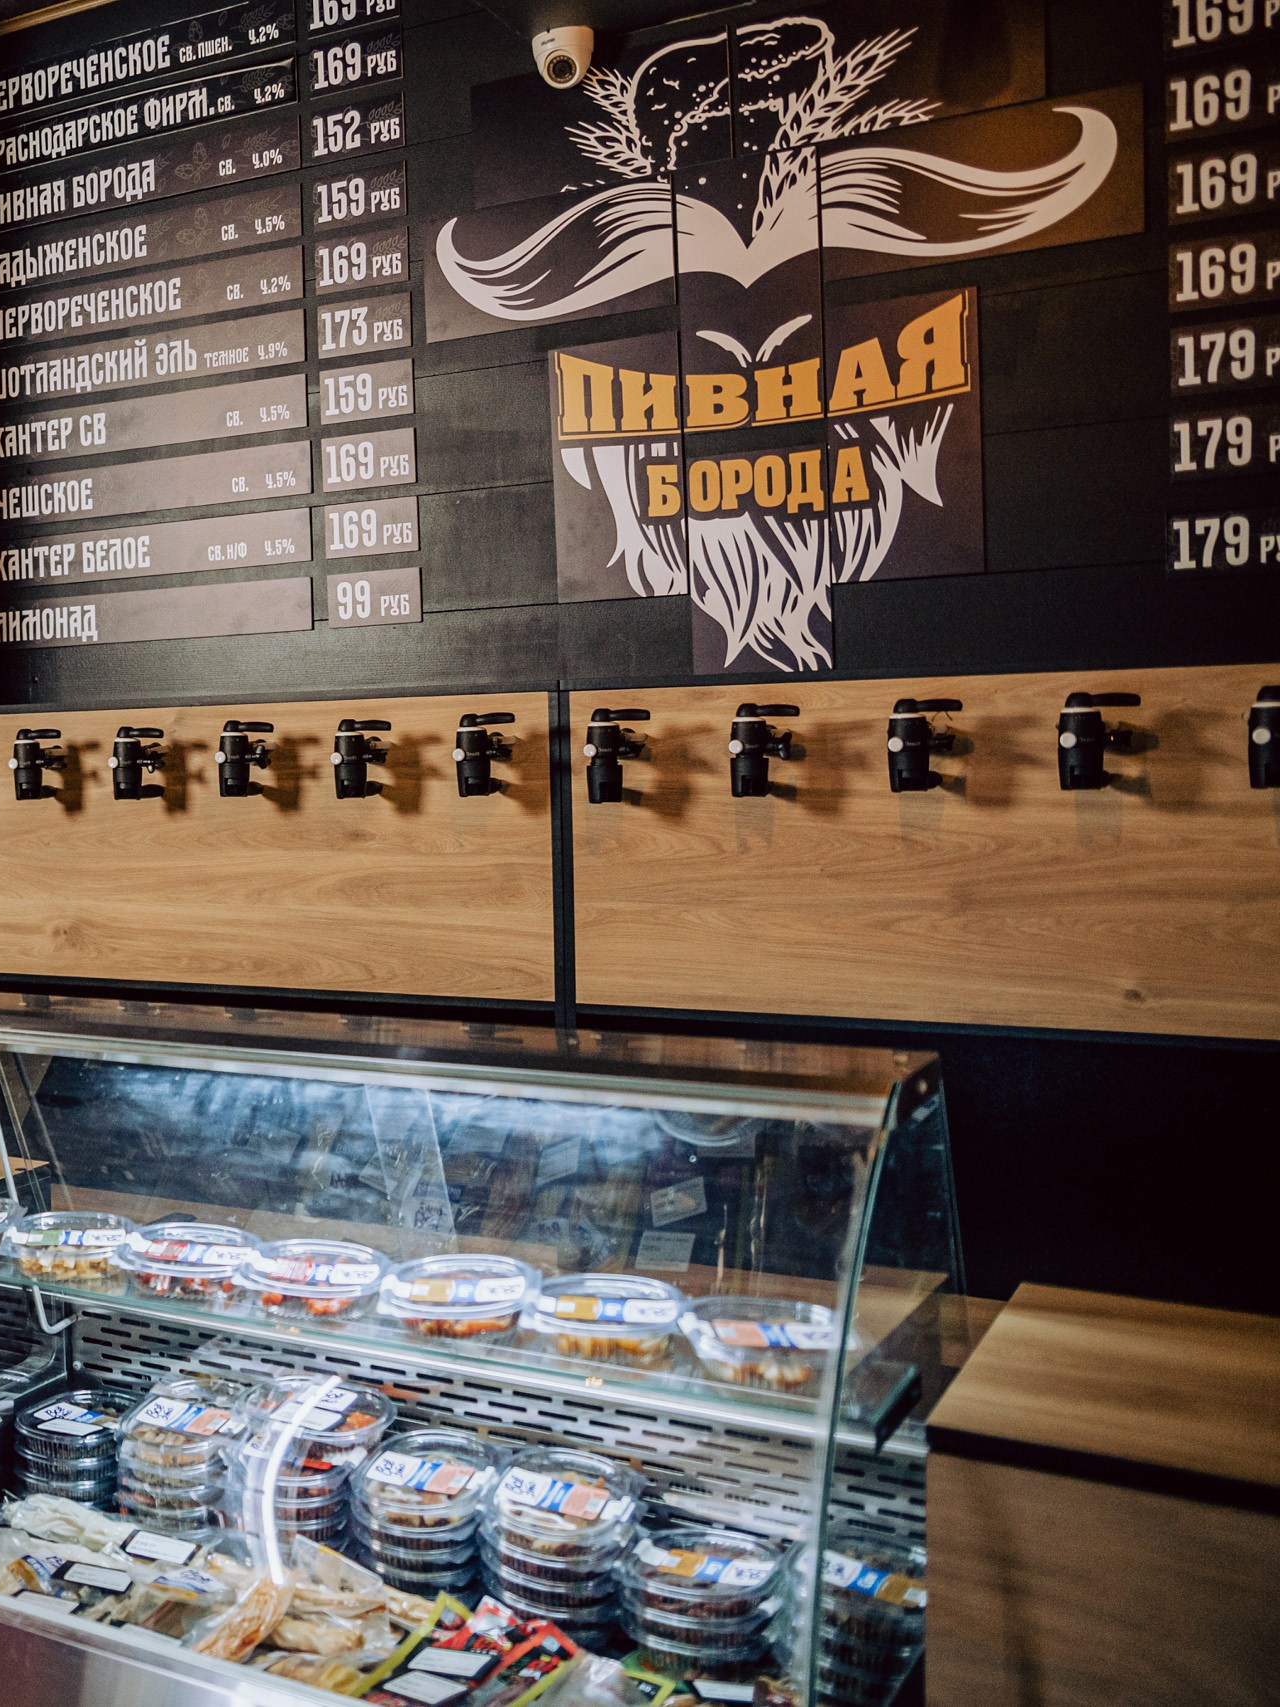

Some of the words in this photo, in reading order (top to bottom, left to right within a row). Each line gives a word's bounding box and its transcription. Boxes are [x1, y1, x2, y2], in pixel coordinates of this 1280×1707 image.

[249, 23, 279, 44] 4.2%
[1173, 0, 1254, 47] 169
[314, 43, 361, 89] 169
[367, 50, 396, 76] РУБ
[143, 86, 215, 131] ФИРМ.
[254, 83, 284, 104] 4.2%
[1170, 70, 1251, 131] 169
[313, 110, 360, 157] 152
[371, 118, 400, 144] РУБ
[73, 159, 155, 208] БОРОДА
[252, 148, 282, 169] 4.0%
[317, 178, 365, 223] 159
[371, 187, 400, 213] РУБ
[1176, 154, 1257, 213] 169
[255, 214, 285, 234] 4.5%
[261, 275, 291, 294] 4.2%
[319, 242, 366, 286] 169
[372, 253, 401, 277] РУБ
[1176, 243, 1256, 301] 169
[321, 307, 368, 350] 173
[374, 319, 403, 343] РУБ
[155, 339, 197, 375] ЭЛЬ
[204, 347, 249, 368] ТЕМНОЕ
[258, 341, 287, 360] 4.9%
[559, 292, 964, 432] ПИВНАЯ
[1178, 329, 1255, 386] 179
[324, 373, 372, 416] 159
[379, 385, 408, 409] РУБ
[80, 413, 106, 446] СВ
[260, 404, 290, 422] 4.5%
[1174, 416, 1252, 472] 179
[266, 471, 296, 488] 4.5%
[326, 441, 374, 484] 169
[380, 454, 409, 477] РУБ
[647, 447, 870, 517] БОРОДА
[329, 509, 376, 550] 169
[383, 522, 412, 545] РУБ
[1173, 516, 1249, 569] 179
[82, 536, 150, 573] БЕЛОЕ
[265, 538, 295, 555] 4.5%
[337, 580, 370, 620] 99
[381, 594, 409, 616] РУБ
